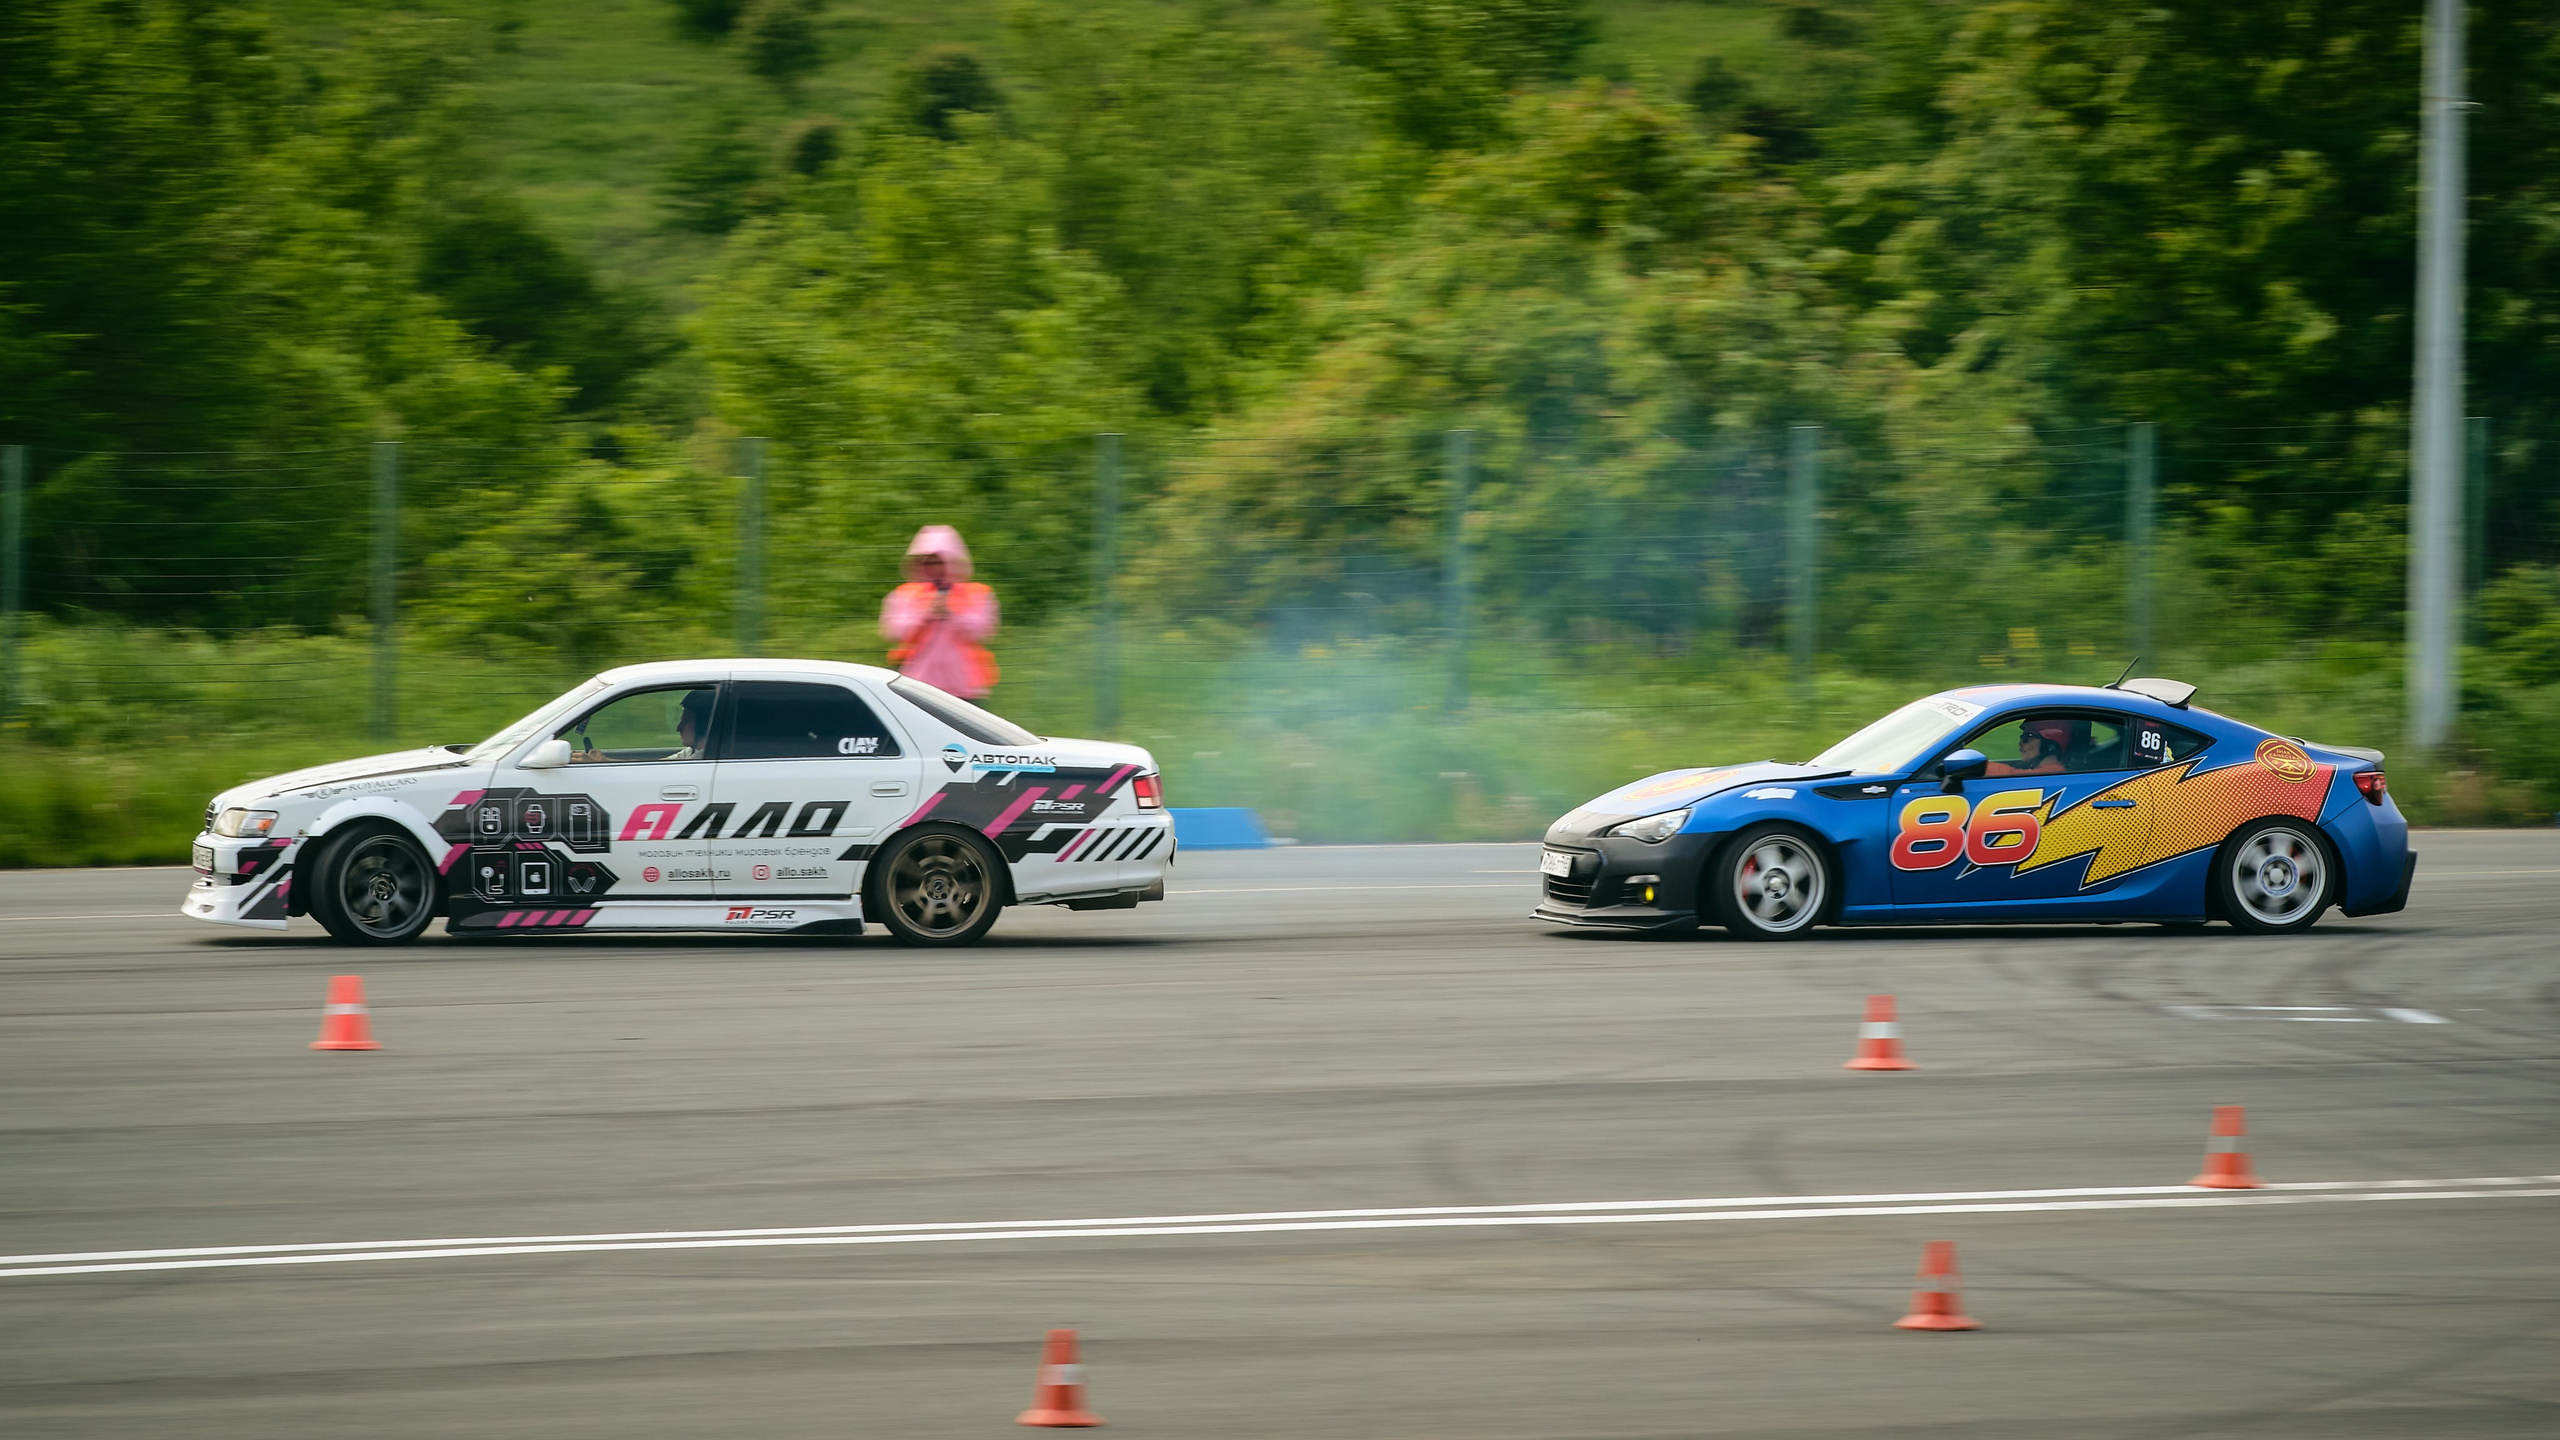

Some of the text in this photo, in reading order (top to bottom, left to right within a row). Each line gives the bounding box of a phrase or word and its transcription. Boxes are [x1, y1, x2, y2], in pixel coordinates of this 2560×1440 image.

[2141, 730, 2161, 750] 86
[970, 754, 1057, 765] АВТОПАК
[617, 801, 852, 841] АЛЛО
[1890, 788, 2043, 871] 86
[638, 846, 831, 859] магазин техники мировых брендов
[668, 867, 731, 879] allosakh.ru
[776, 866, 827, 878] allo.sakh
[750, 910, 796, 919] PSR
